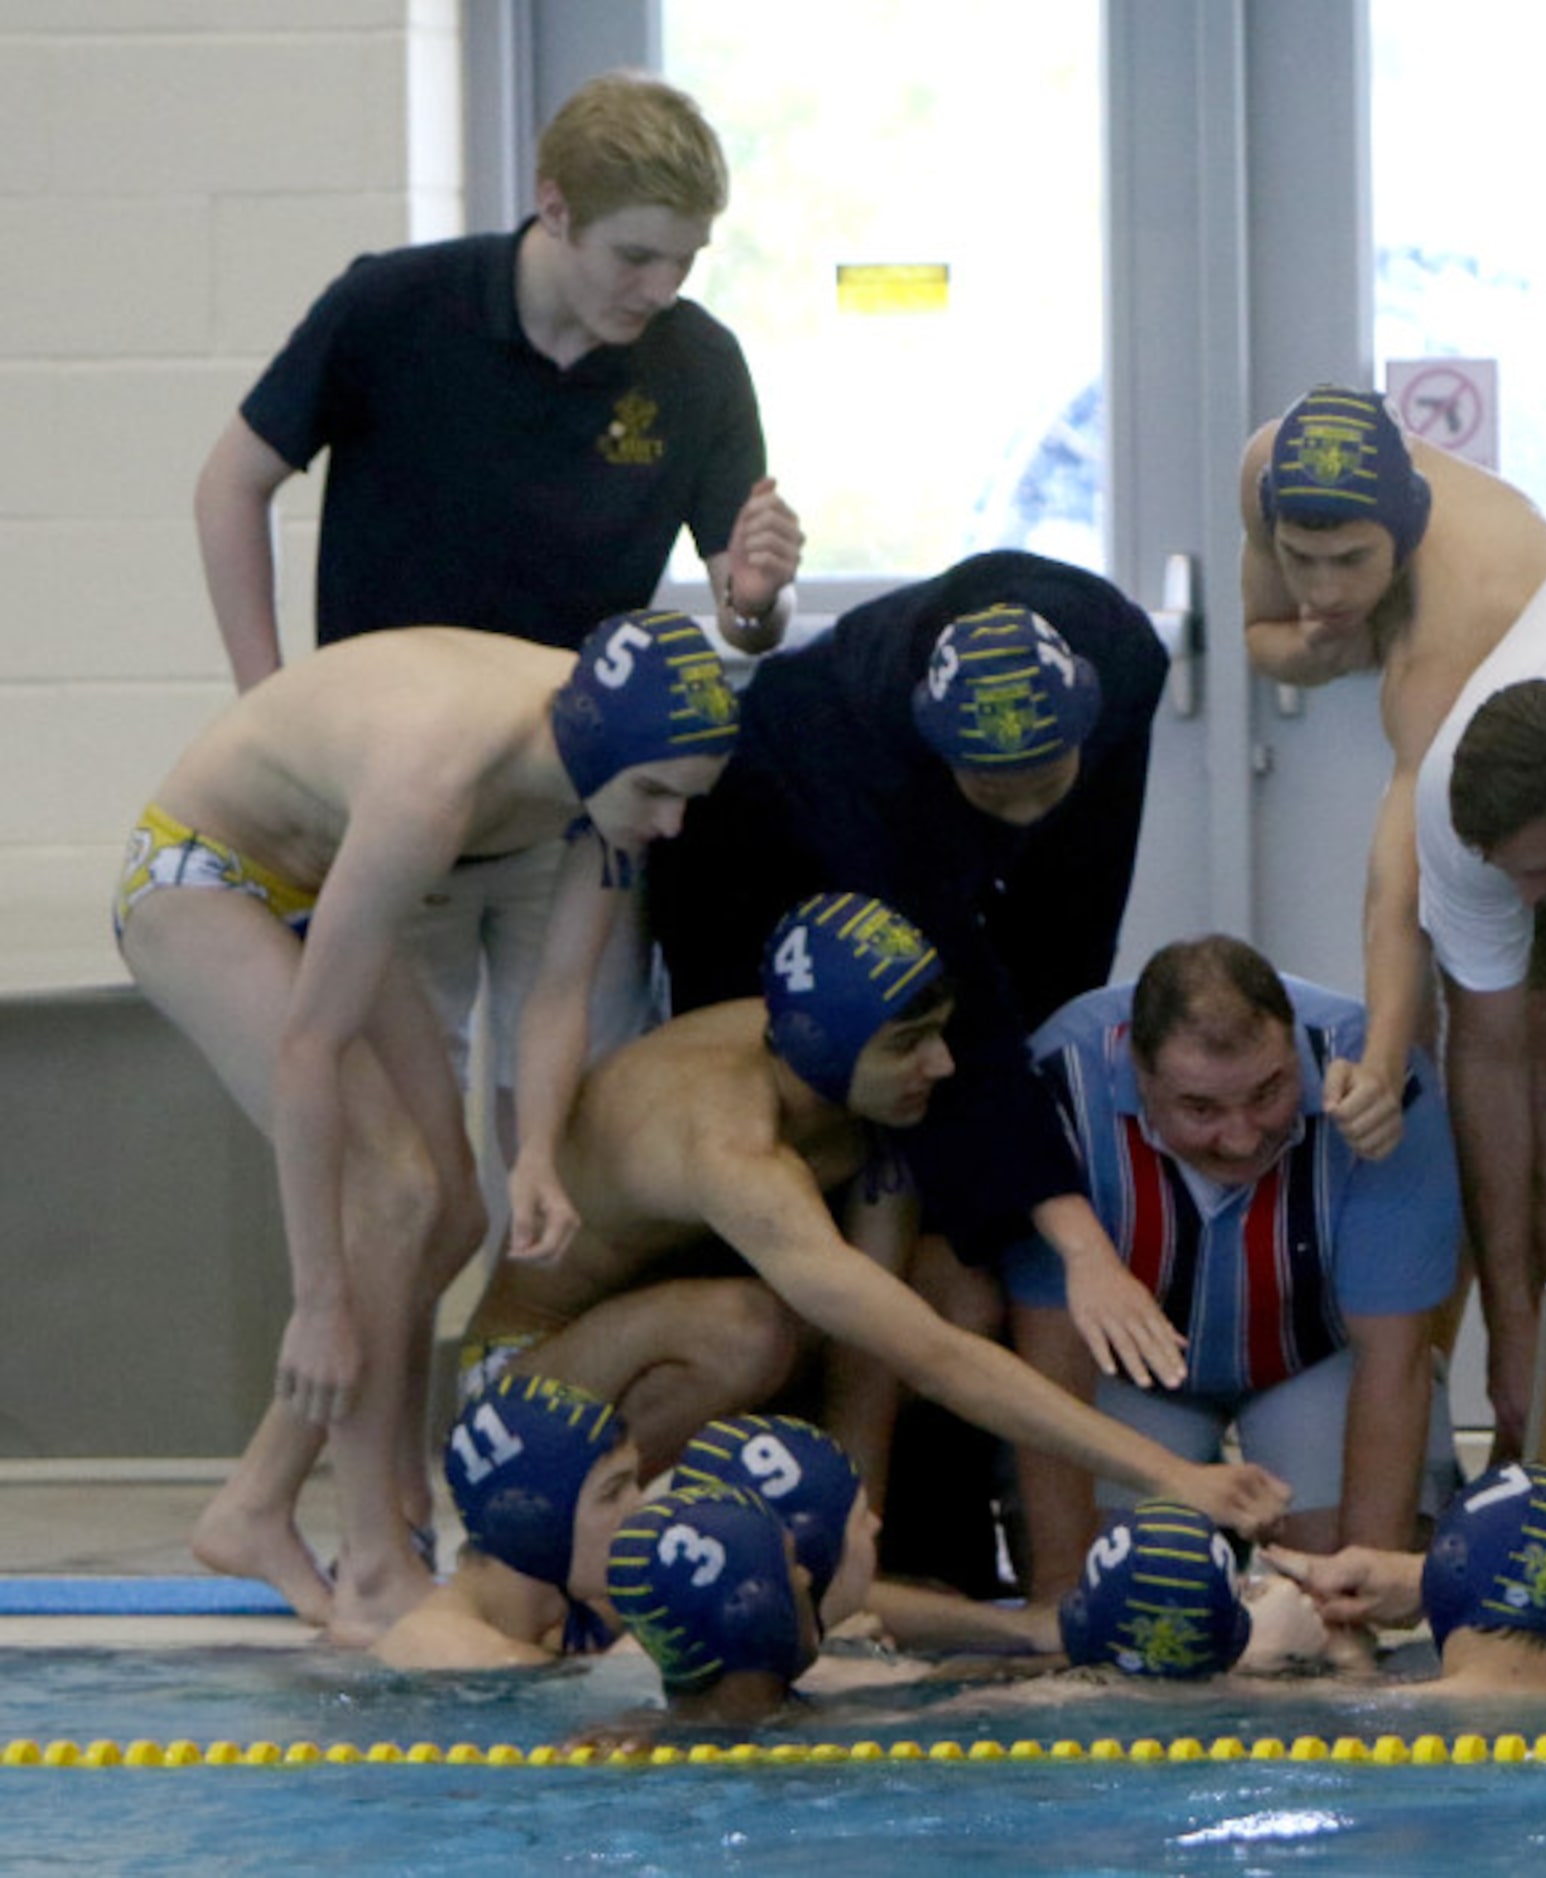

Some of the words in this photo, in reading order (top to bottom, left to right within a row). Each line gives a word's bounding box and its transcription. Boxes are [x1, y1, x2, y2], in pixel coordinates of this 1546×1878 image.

[594, 621, 653, 689] 5
[774, 926, 815, 992] 4
[451, 1402, 524, 1486] 11
[741, 1434, 801, 1498] 9
[1463, 1463, 1532, 1513] 7
[658, 1523, 726, 1587] 3
